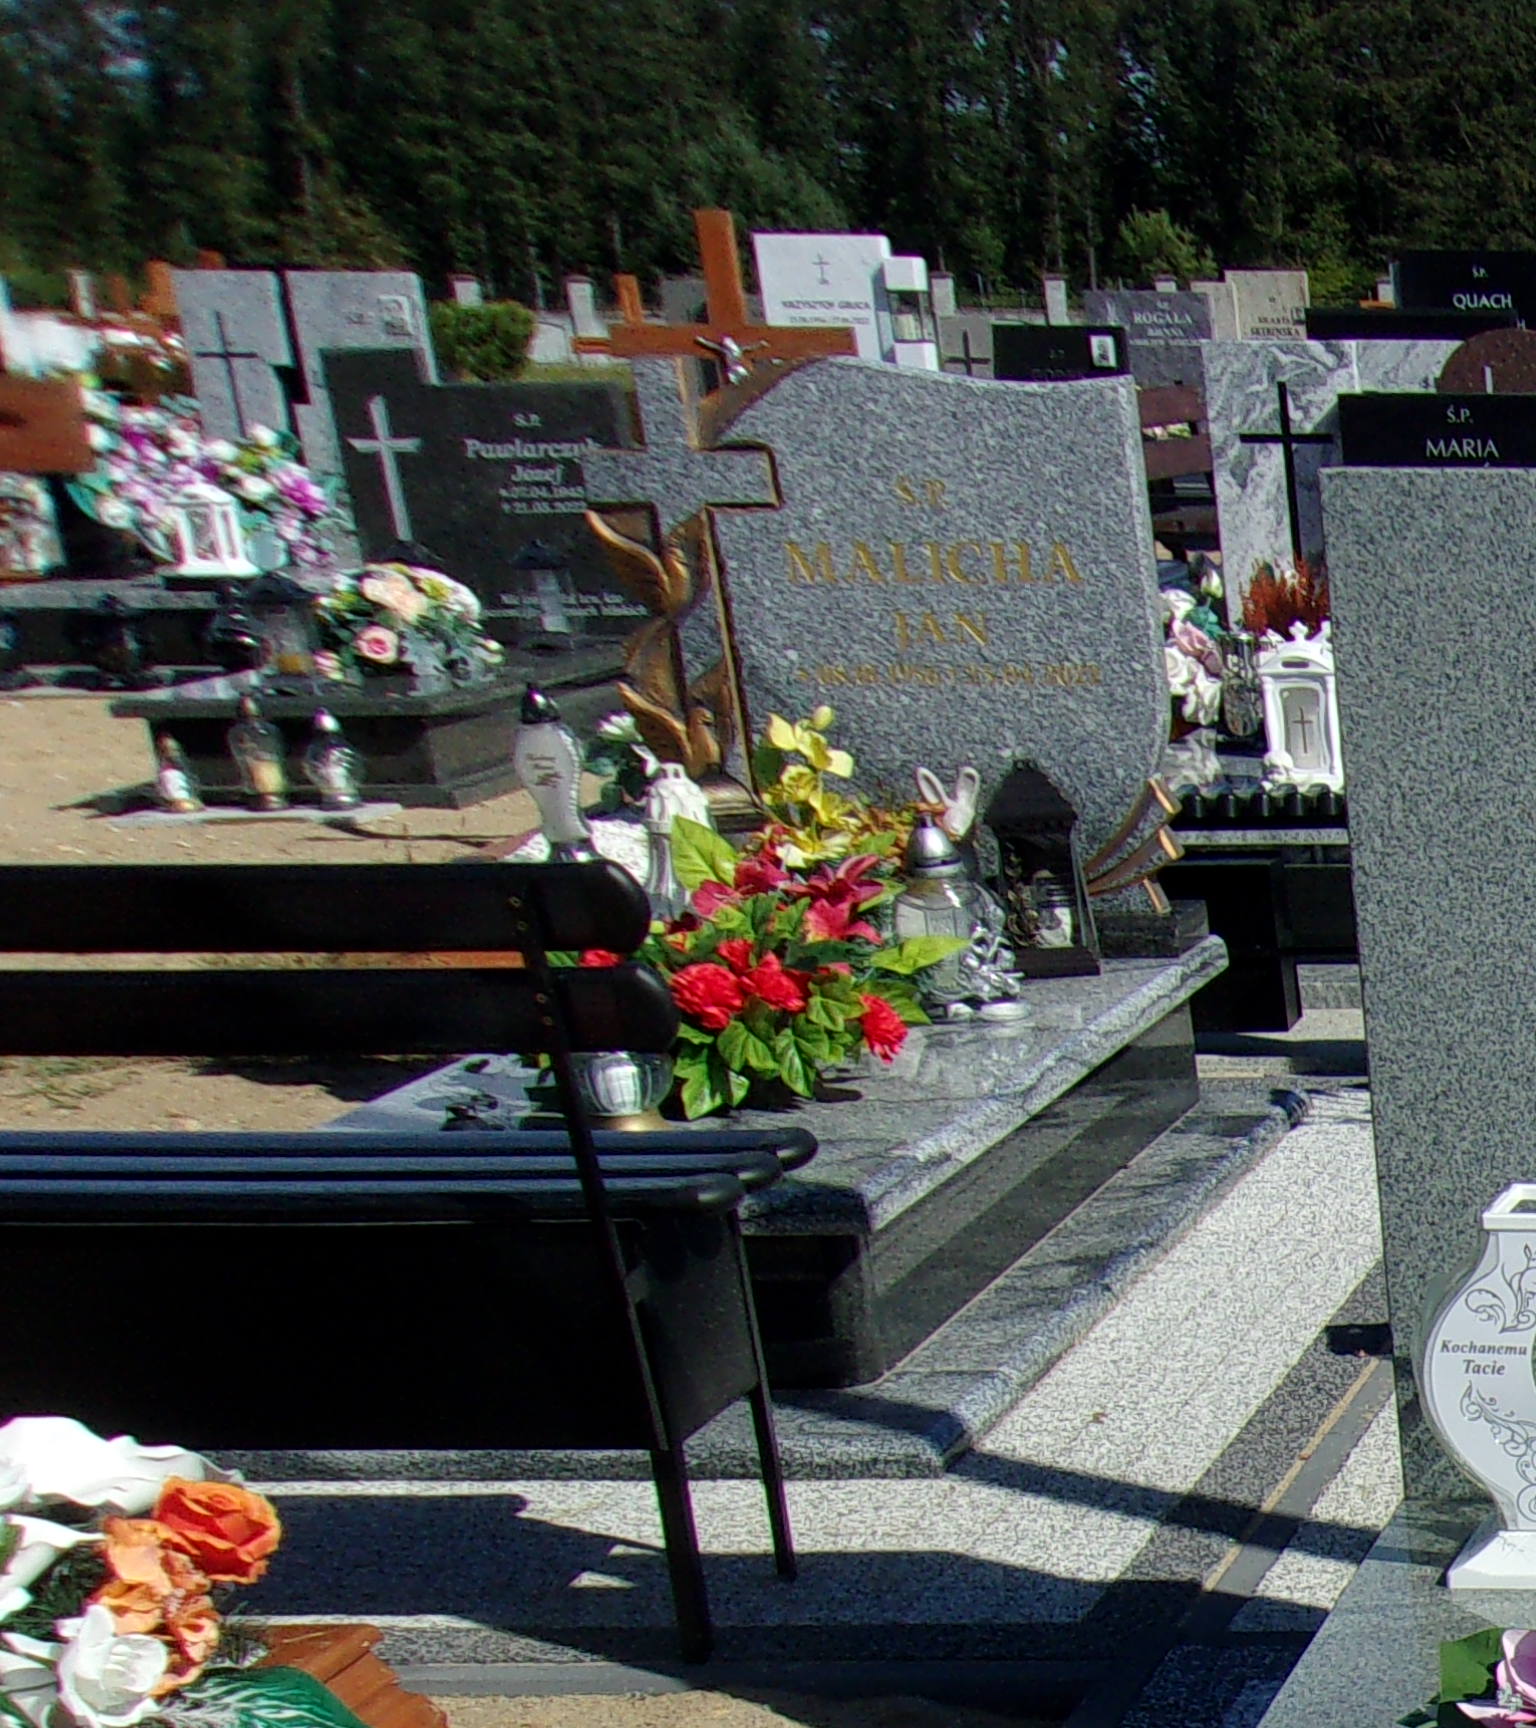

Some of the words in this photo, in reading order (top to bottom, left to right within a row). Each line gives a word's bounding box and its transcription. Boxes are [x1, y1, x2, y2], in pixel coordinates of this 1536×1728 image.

[1453, 293, 1513, 310] QUACH
[1426, 437, 1500, 458] MARIA
[785, 539, 1084, 586] MALICHA
[893, 610, 990, 651] JAN
[1440, 1339, 1528, 1357] Kochanemu
[1462, 1359, 1507, 1376] Tacie
